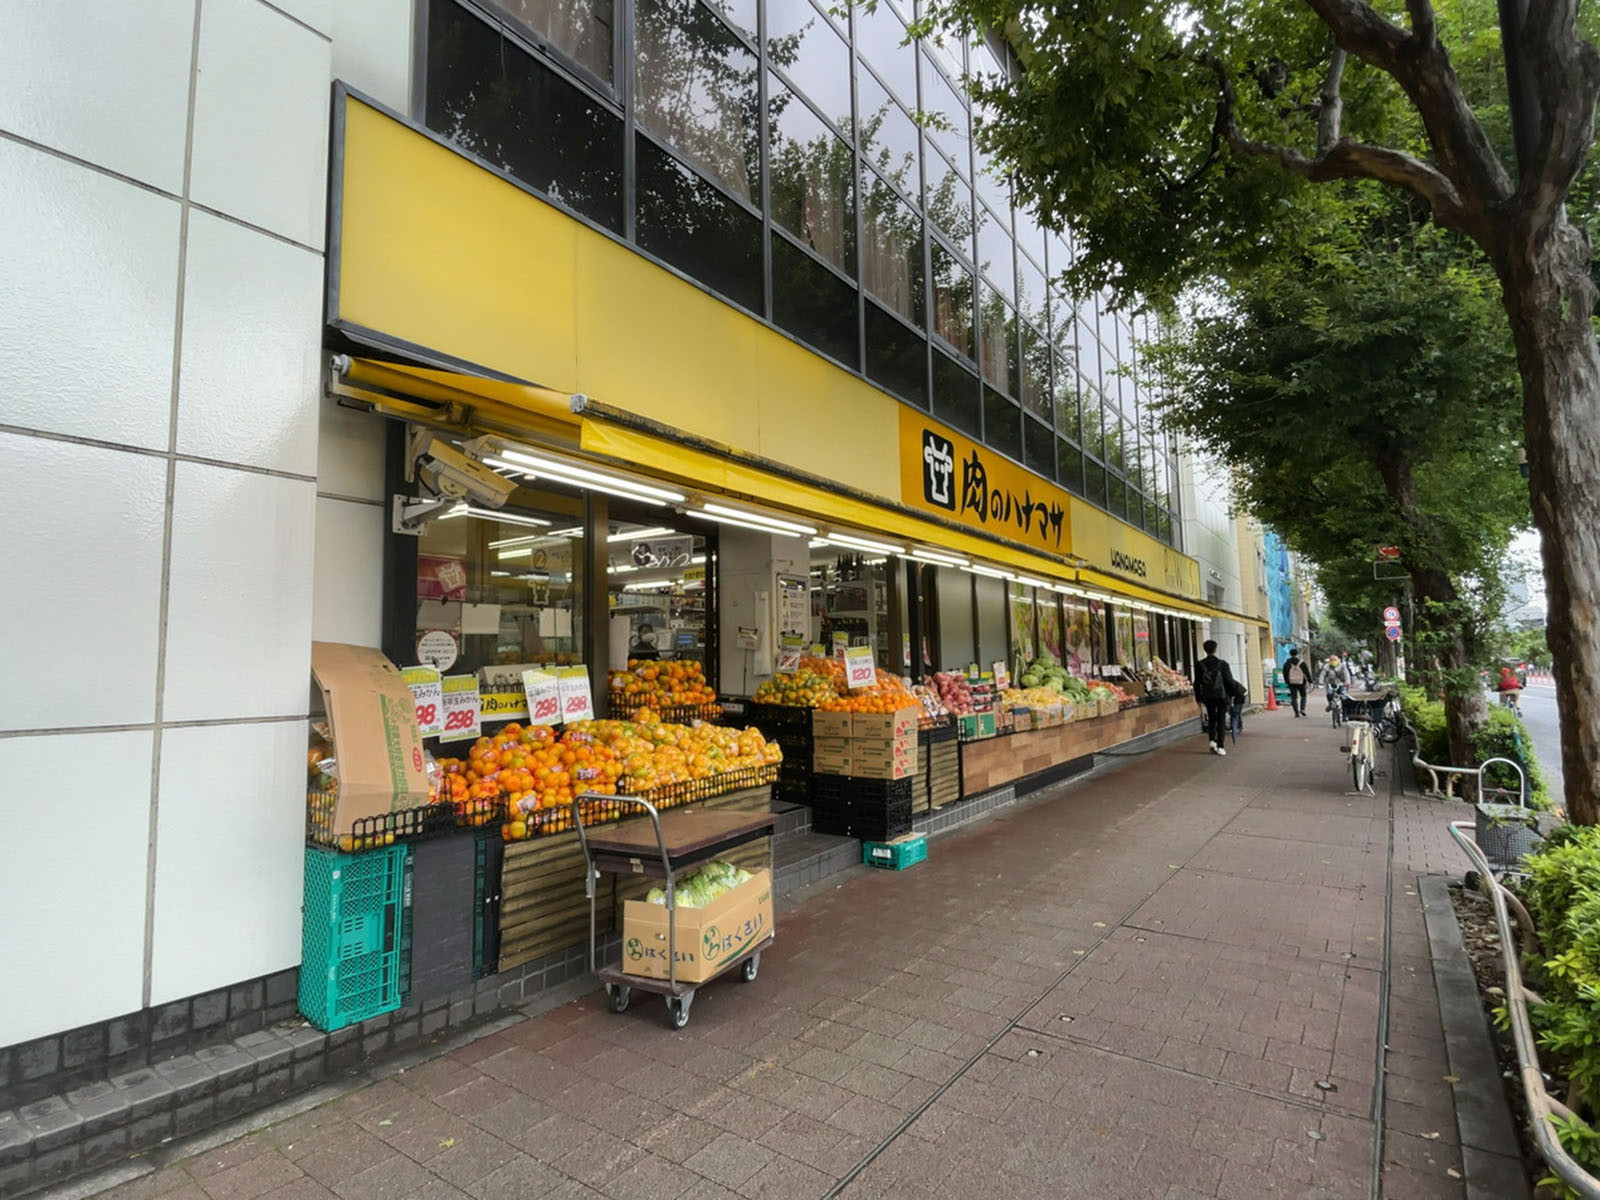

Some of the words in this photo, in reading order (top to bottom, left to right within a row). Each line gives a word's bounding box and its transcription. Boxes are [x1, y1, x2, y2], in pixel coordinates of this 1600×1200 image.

[960, 449, 1065, 547] 肉のハナマサ
[852, 667, 871, 681] 120
[535, 696, 558, 719] 298
[565, 695, 588, 714] 298
[444, 709, 474, 731] 298
[721, 912, 764, 953] はくさい
